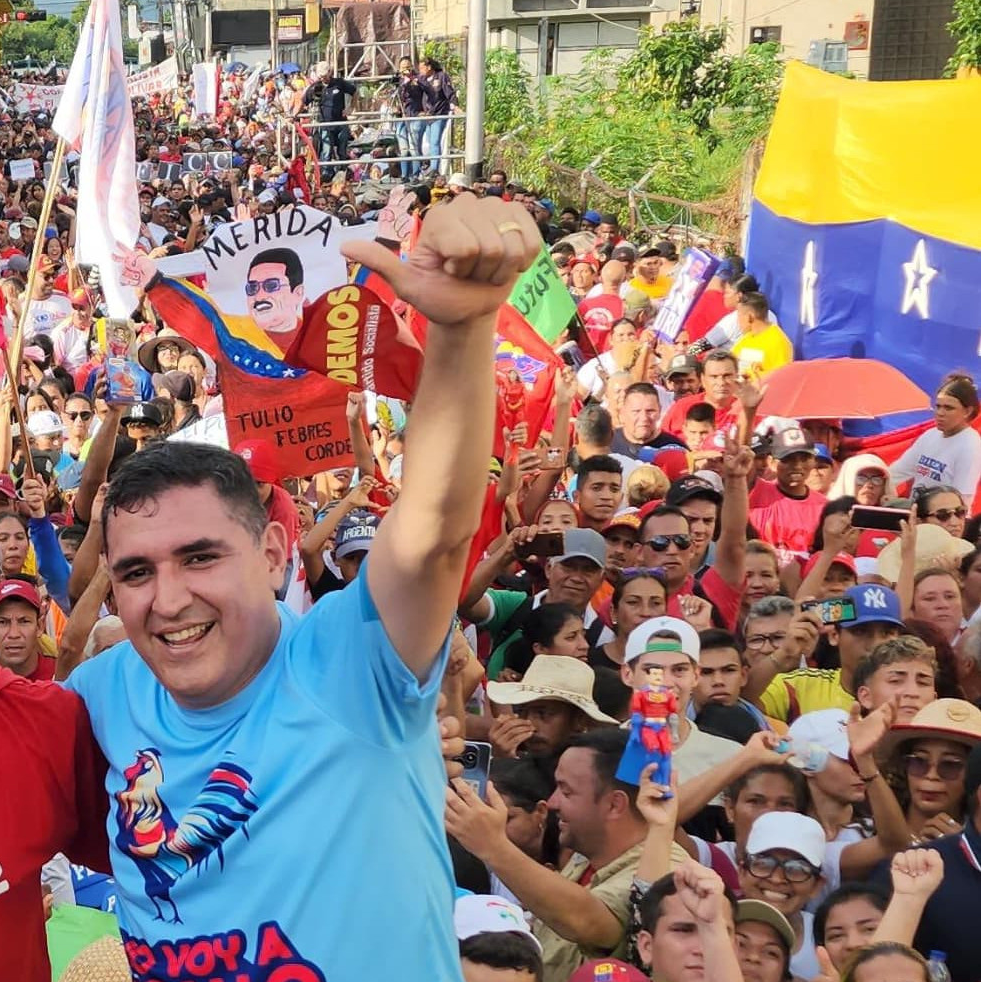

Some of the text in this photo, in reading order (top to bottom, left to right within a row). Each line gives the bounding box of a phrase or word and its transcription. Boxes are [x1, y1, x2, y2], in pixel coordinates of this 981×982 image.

[203, 208, 332, 270] MERIDA
[361, 356, 376, 392] artido
[236, 405, 294, 432] TULIO
[274, 422, 333, 448] FEBRES
[864, 588, 887, 608] NY
[159, 932, 244, 979] VOY
[256, 922, 298, 967] A
